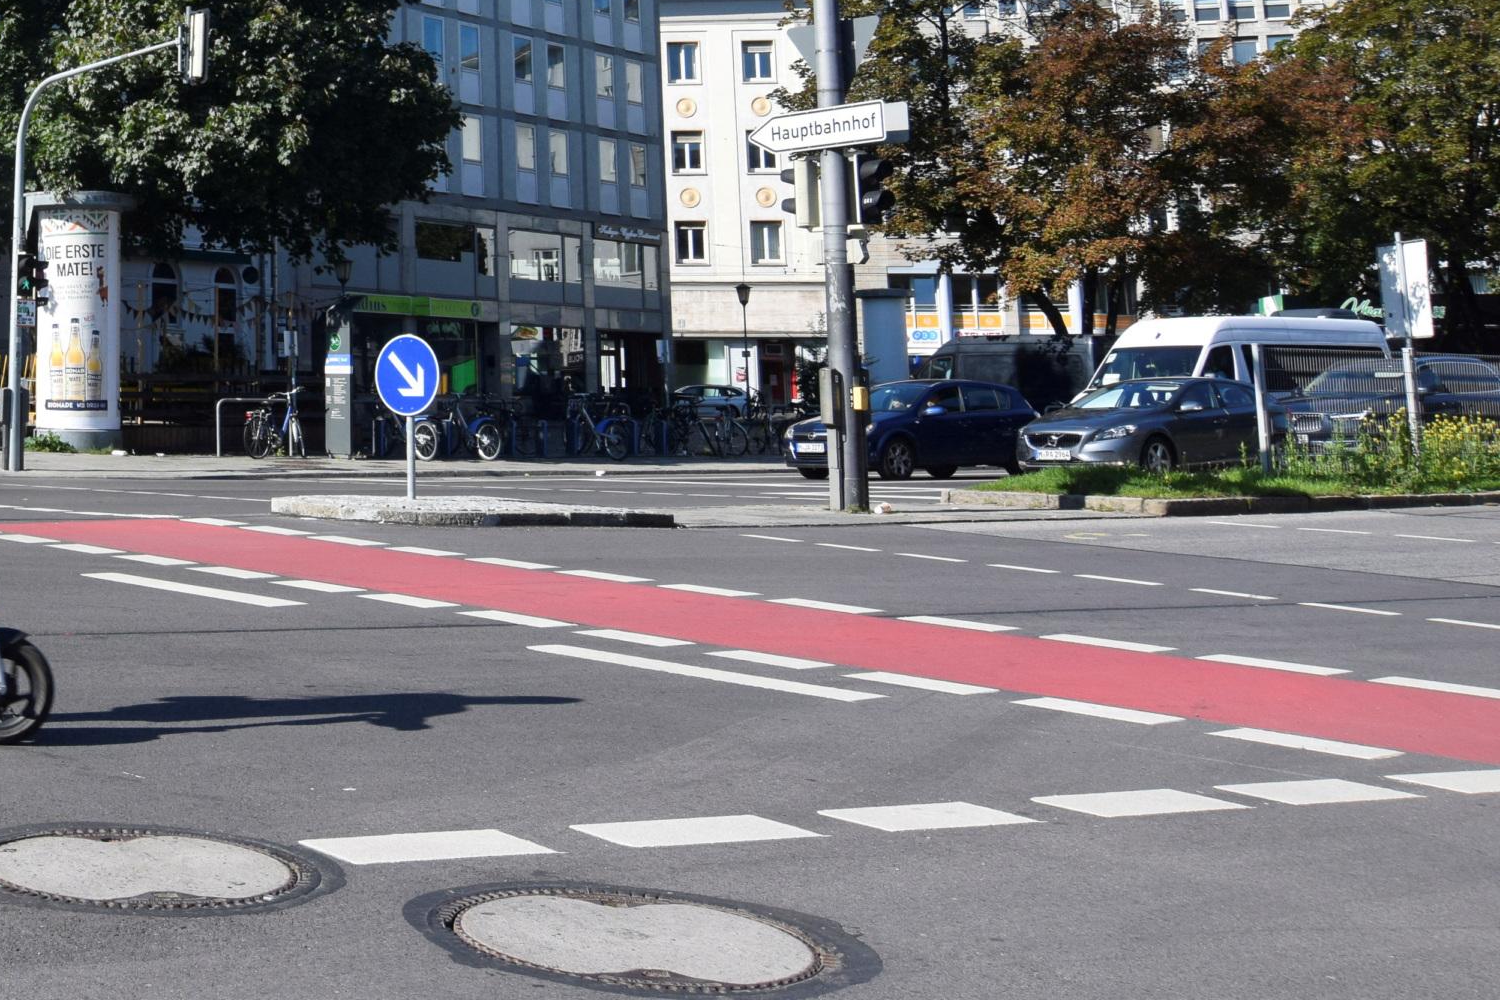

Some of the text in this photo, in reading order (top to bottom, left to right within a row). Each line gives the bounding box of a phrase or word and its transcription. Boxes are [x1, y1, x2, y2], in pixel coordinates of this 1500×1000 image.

[771, 113, 876, 141] Hauptbahnhof
[45, 244, 105, 260] DIE ERSTE
[56, 262, 93, 277] MATE!
